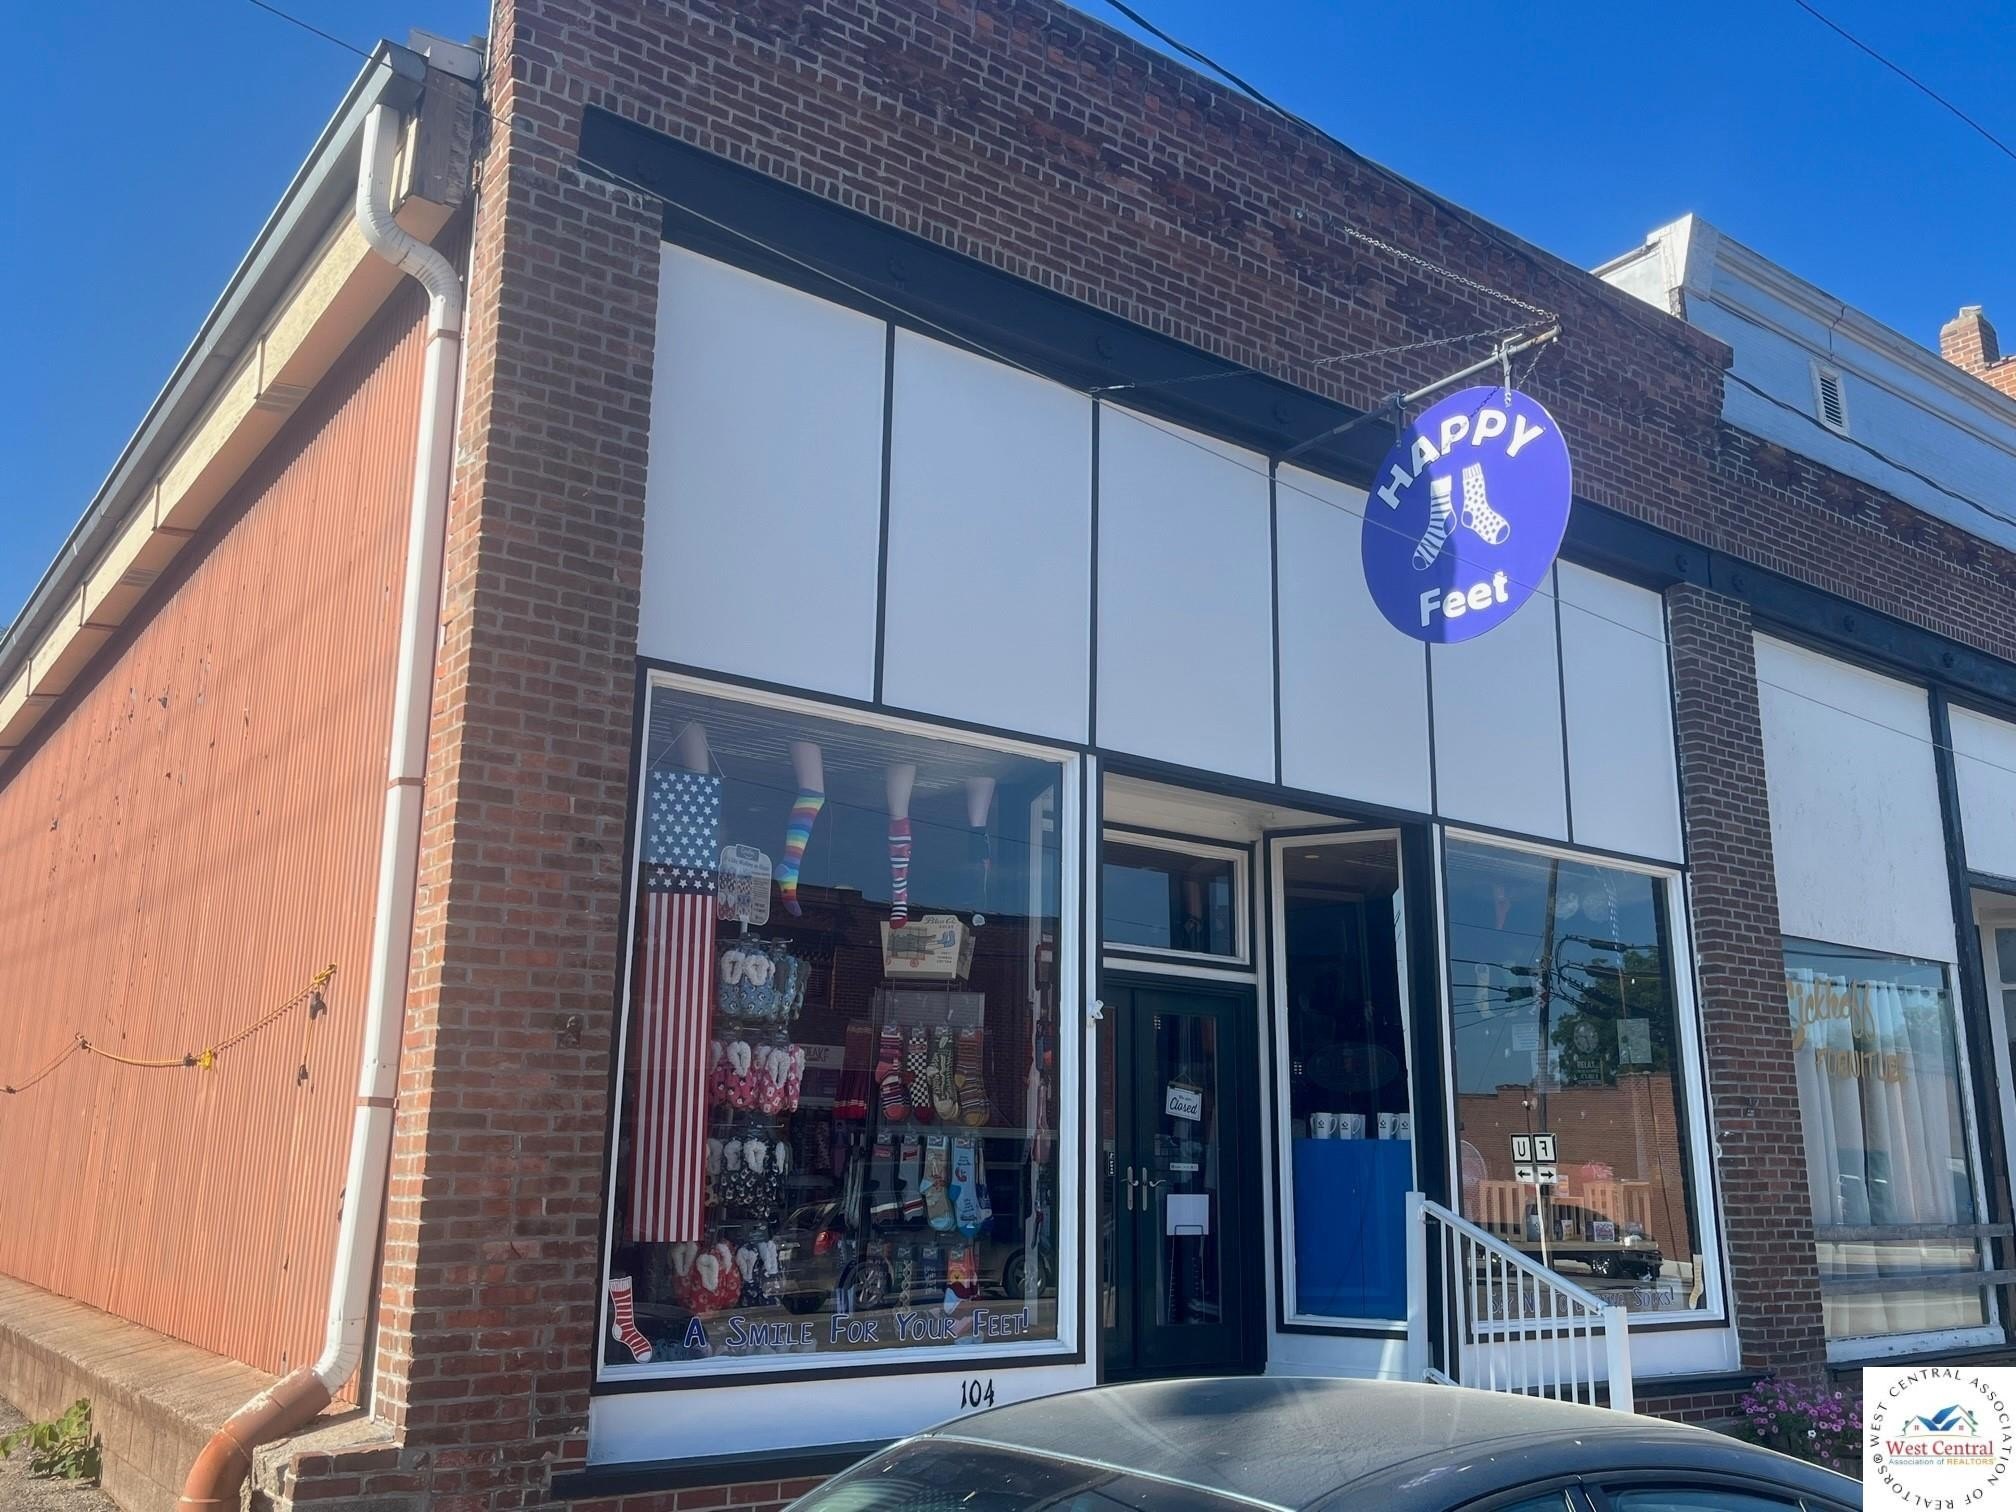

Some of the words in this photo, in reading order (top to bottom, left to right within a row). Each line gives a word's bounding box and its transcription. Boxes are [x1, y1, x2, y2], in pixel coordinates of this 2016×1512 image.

[1376, 409, 1546, 510] HAPPY
[1419, 571, 1509, 627] Feet
[1169, 1096, 1198, 1114] Closed
[1632, 1285, 1674, 1307] SOCKS!
[683, 1316, 707, 1349] A
[725, 1315, 814, 1347] SMILE
[830, 1313, 879, 1344] FOR
[896, 1311, 957, 1341] YOUR
[972, 1307, 1031, 1338] FEET!
[960, 1378, 996, 1410] 104
